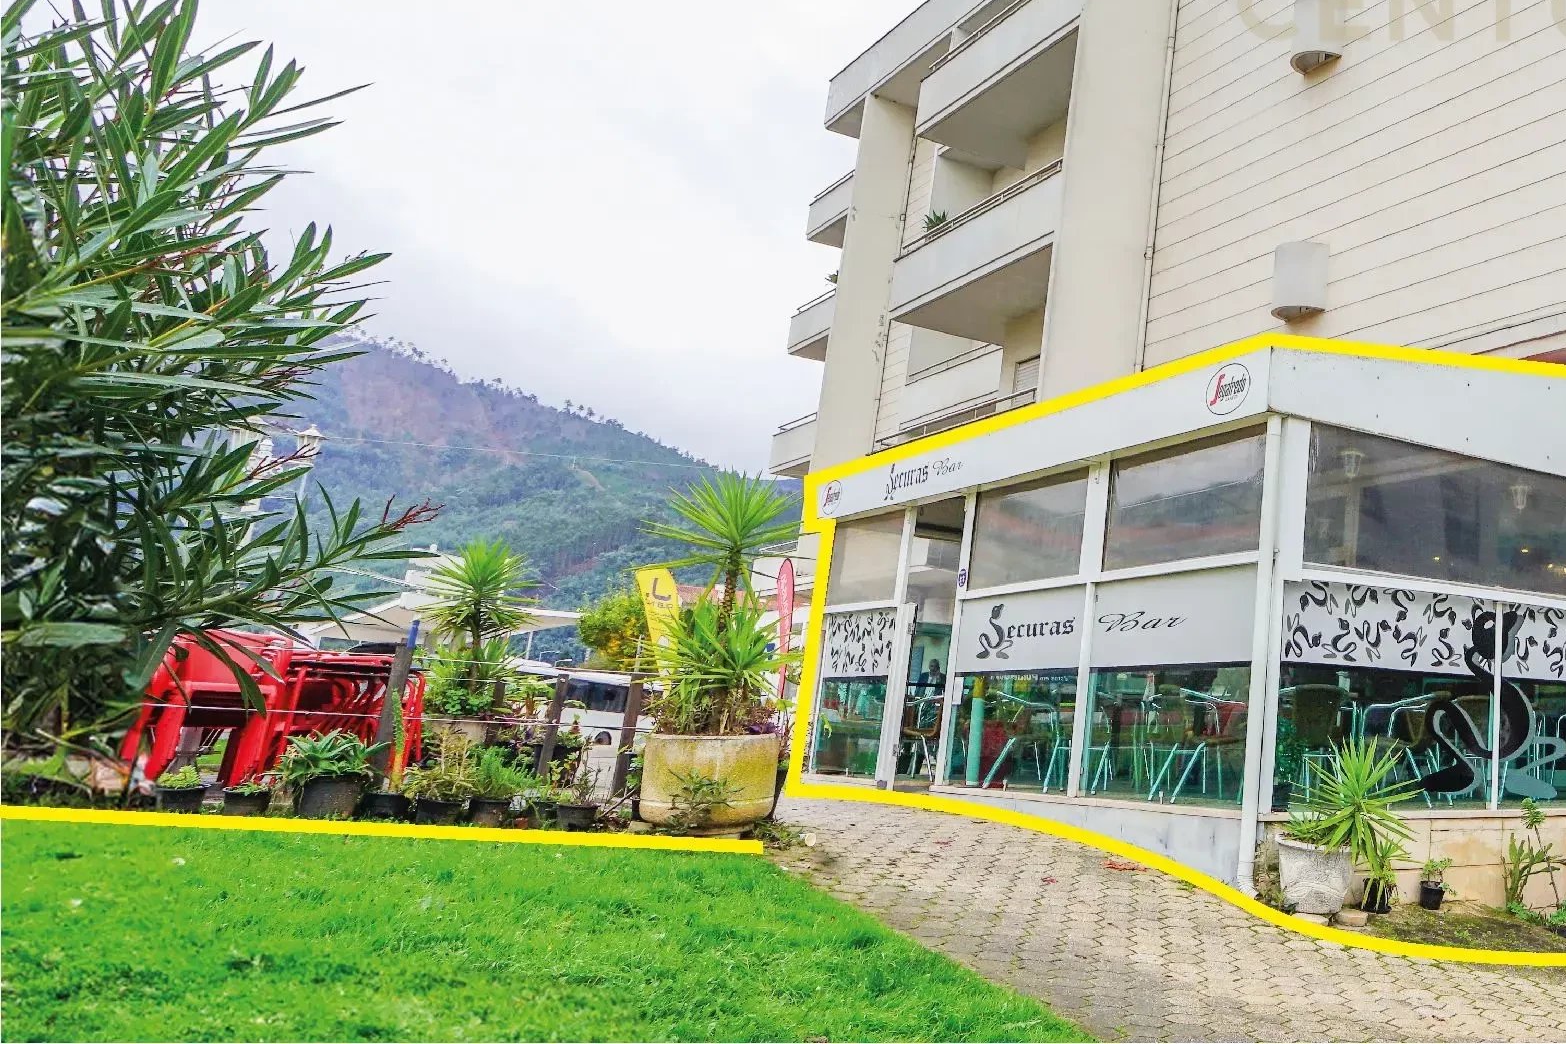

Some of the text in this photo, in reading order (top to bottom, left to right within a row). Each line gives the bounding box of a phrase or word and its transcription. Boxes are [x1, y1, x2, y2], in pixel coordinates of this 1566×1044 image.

[884, 457, 963, 500] Securas Bar
[976, 603, 1188, 659] Securas Bar
